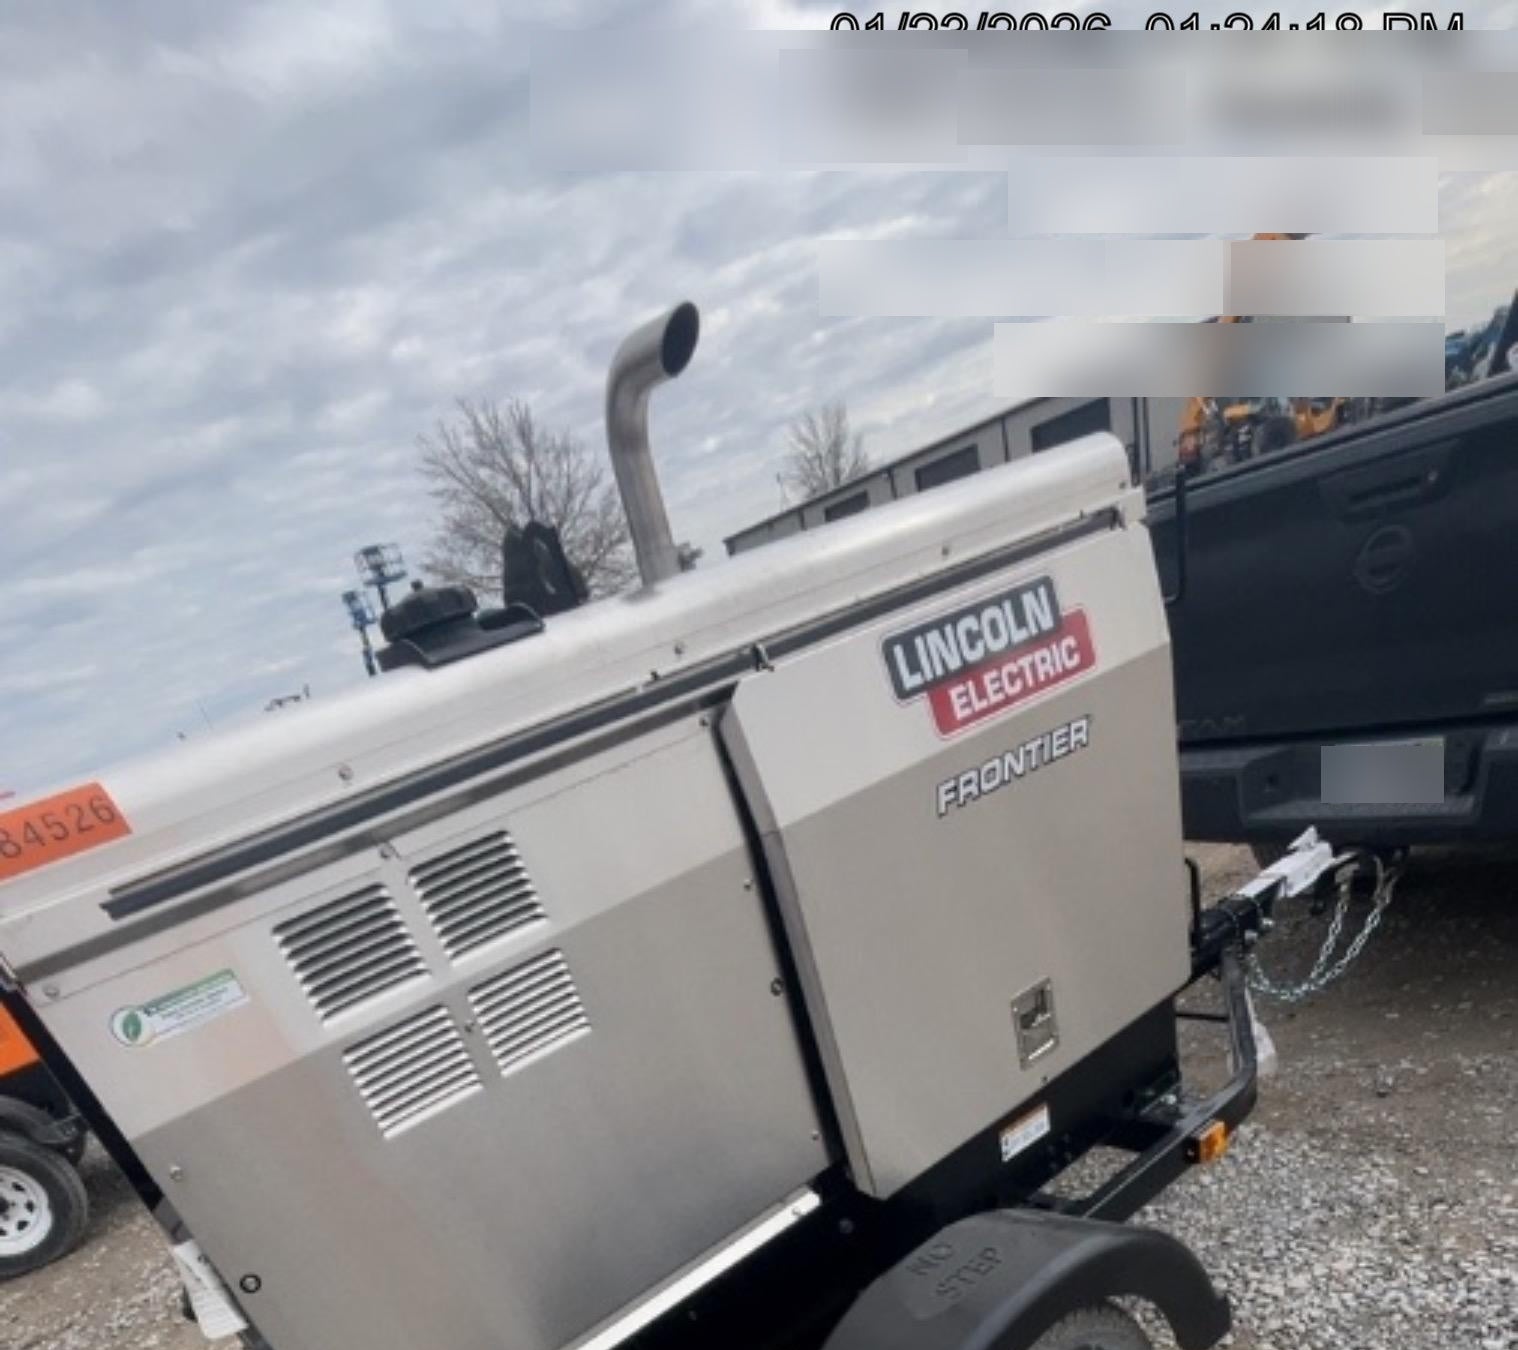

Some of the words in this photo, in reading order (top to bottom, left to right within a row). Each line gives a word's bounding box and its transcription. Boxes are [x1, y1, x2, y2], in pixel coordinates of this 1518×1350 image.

[893, 585, 1055, 691] LINCOLN
[948, 635, 1082, 721] ELECTRIC
[936, 717, 1090, 818] FRONTIER
[904, 1243, 954, 1277] NO
[935, 1246, 1002, 1300] STEP
